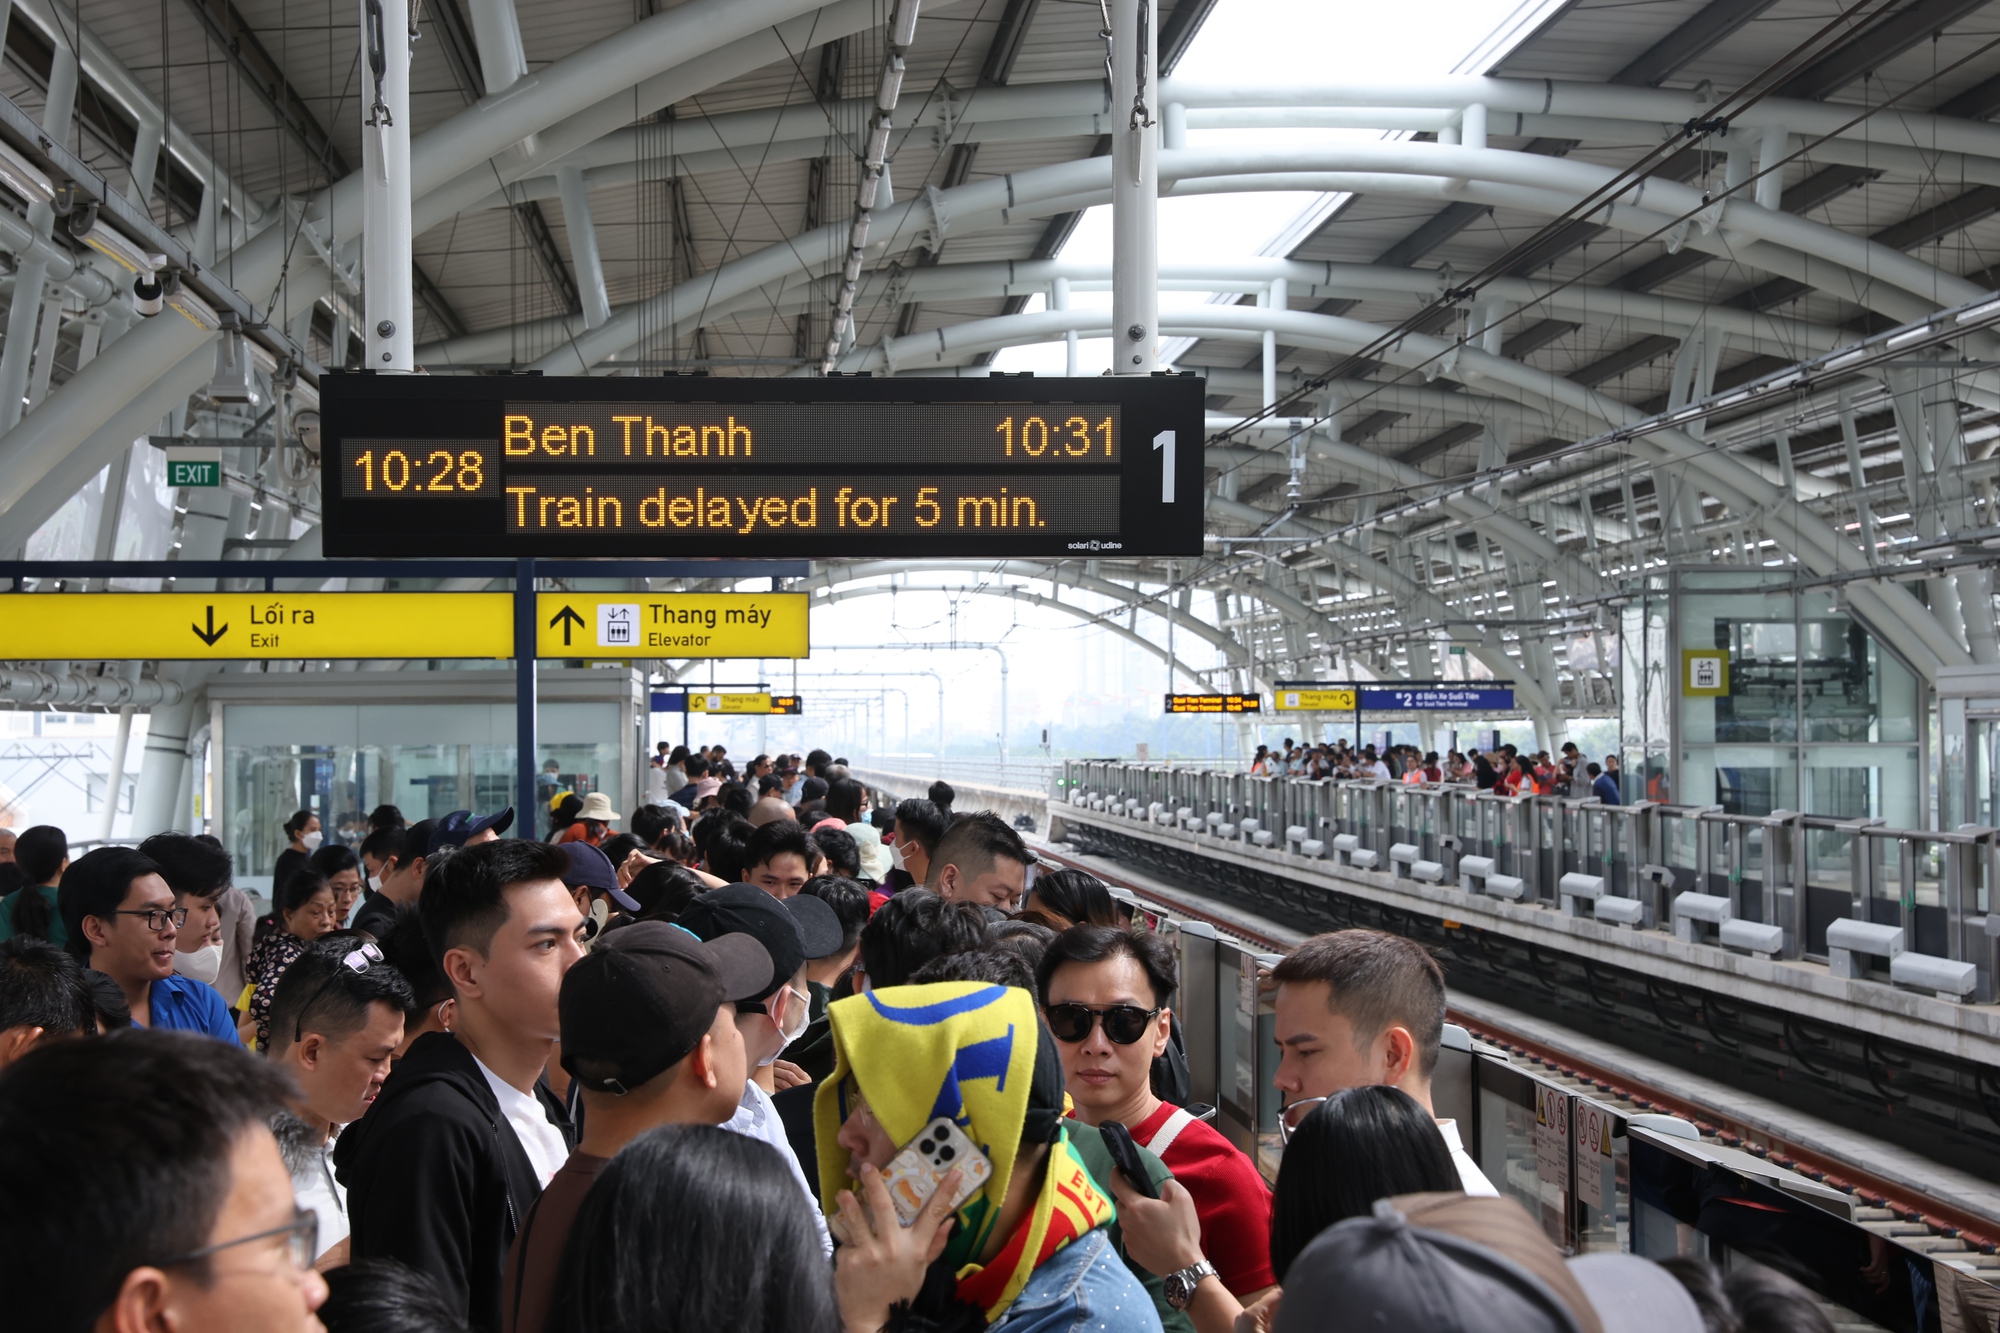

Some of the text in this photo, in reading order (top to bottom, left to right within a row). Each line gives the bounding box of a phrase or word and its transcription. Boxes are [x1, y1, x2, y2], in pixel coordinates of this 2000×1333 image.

[505, 415, 752, 456] Ben Thanh
[996, 416, 1114, 456] 10:31
[175, 464, 212, 483] EXIT
[355, 450, 483, 491] 10:28
[1152, 430, 1176, 503] 1
[506, 487, 1045, 533] Train delayed for 5 min.
[1067, 541, 1122, 550] solari udine
[250, 602, 315, 625] Lối ra
[649, 603, 771, 628] Thang máy
[250, 633, 280, 648] Exit
[649, 632, 711, 647] Elevator
[1403, 692, 1413, 707] 2
